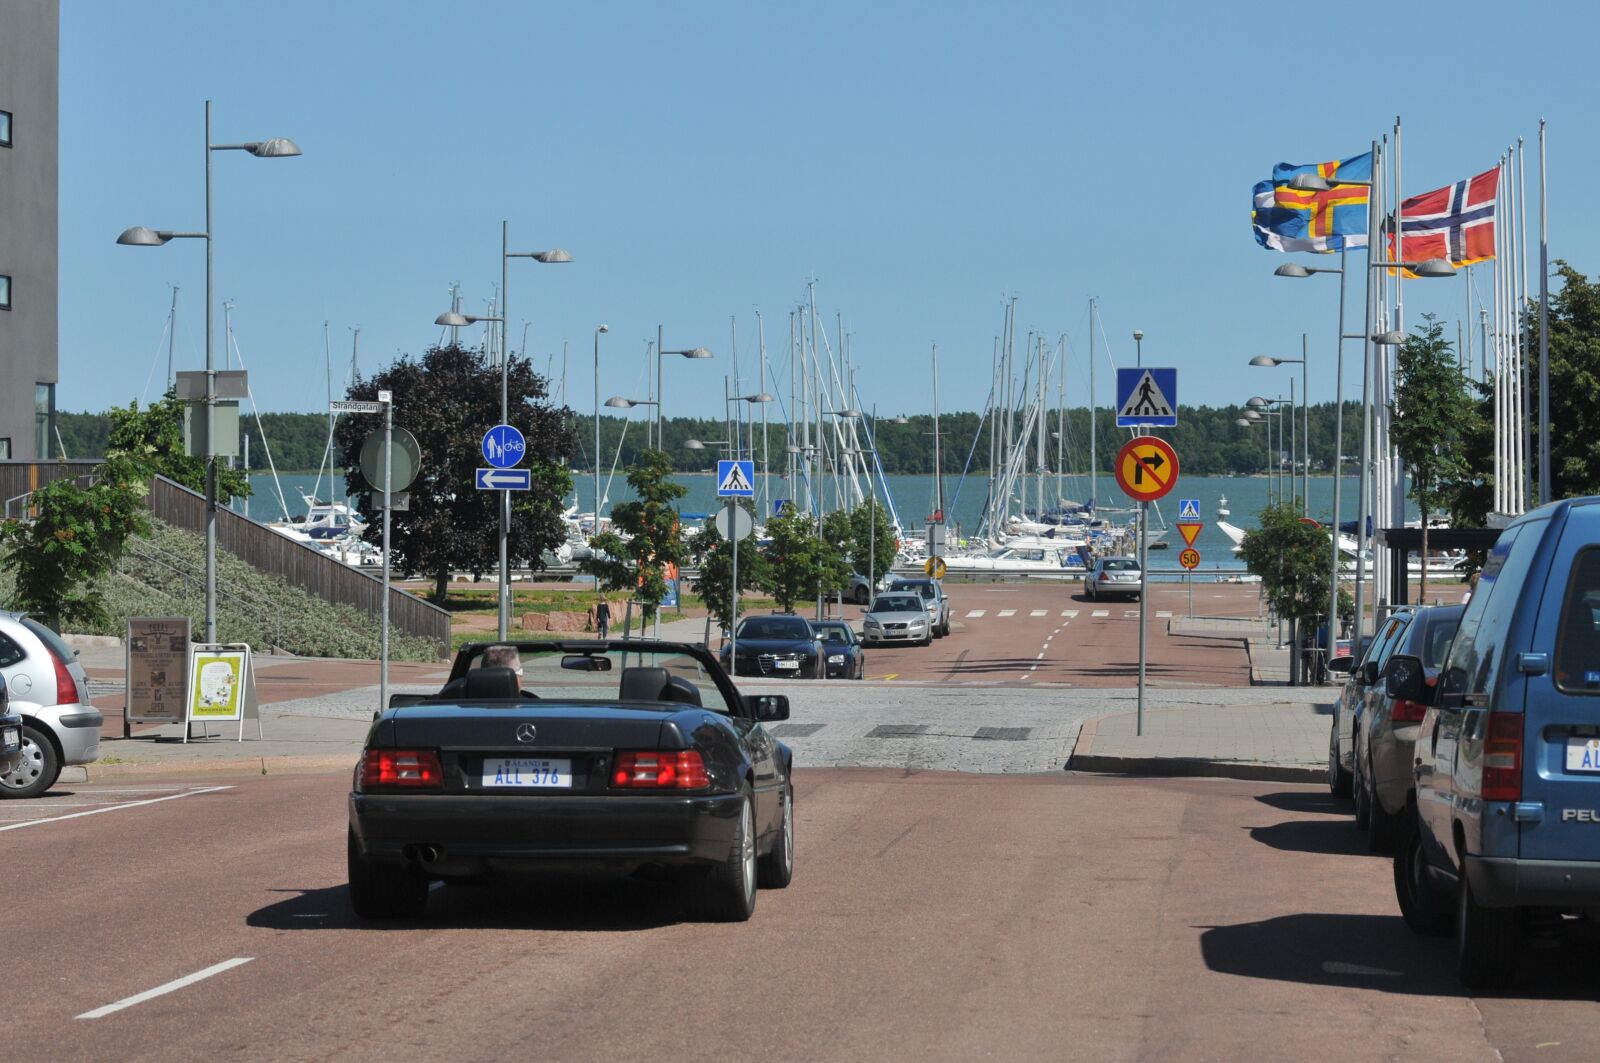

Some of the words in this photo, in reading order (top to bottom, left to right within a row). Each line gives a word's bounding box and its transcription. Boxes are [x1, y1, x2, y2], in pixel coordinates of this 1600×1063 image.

[333, 402, 378, 411] Strandgatan
[1184, 554, 1196, 564] 50
[532, 767, 558, 784] 376
